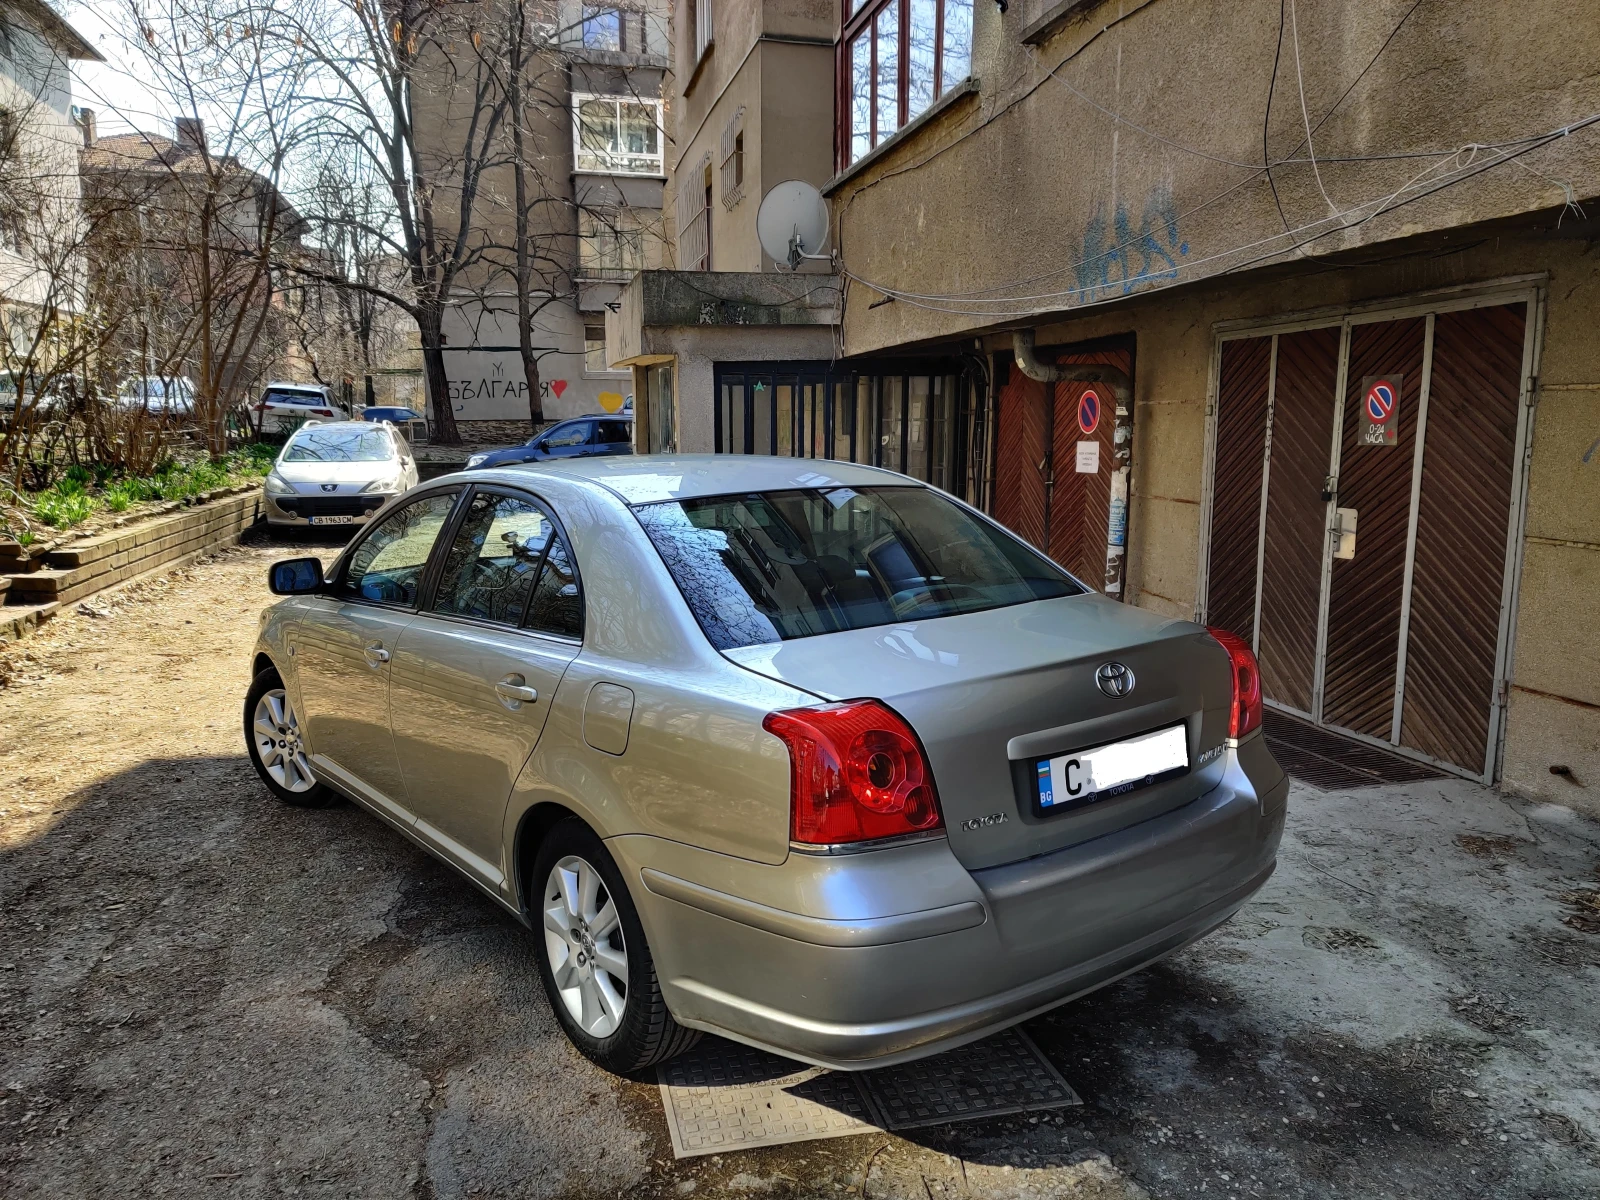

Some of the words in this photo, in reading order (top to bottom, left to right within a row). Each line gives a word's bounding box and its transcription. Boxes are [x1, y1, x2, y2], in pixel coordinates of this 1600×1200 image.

[447, 378, 549, 400] БЪЛГАРЯ
[1369, 424, 1385, 434] 0-24
[1365, 433, 1384, 444] ЧАСА
[1110, 782, 1135, 797] TOYOTA
[1040, 791, 1052, 804] BG
[960, 812, 1009, 832] TOYOTA
